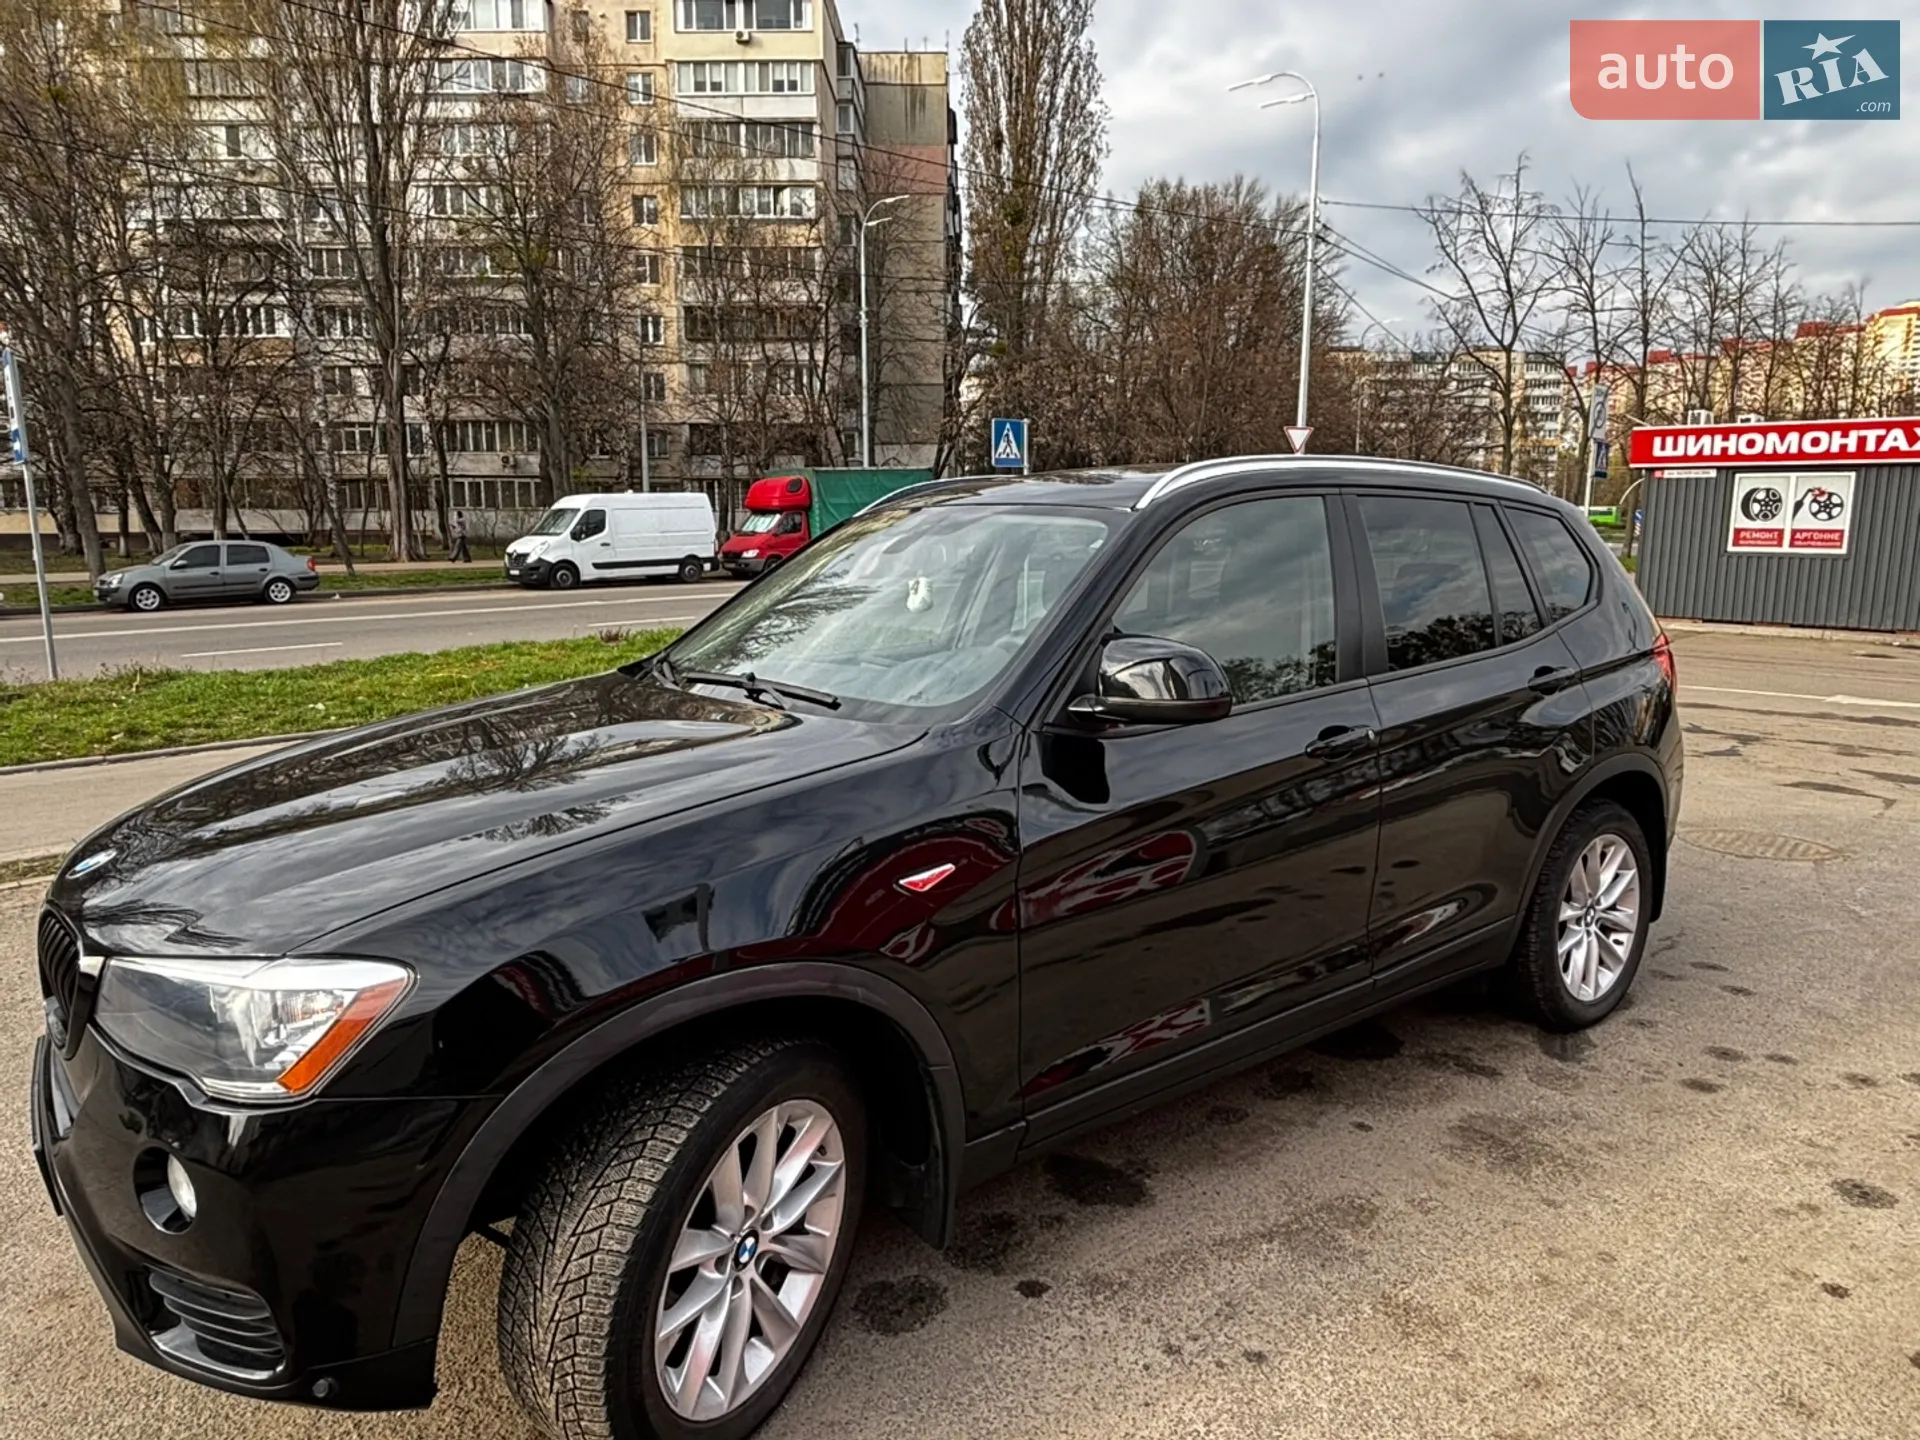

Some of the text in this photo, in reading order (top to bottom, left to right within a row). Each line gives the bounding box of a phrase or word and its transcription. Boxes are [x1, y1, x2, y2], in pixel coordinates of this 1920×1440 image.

[1652, 427, 1920, 457] ШИНОМОНТА
[1739, 530, 1779, 540] РЕМОНТ
[1794, 531, 1841, 541] АРГОННЕ
